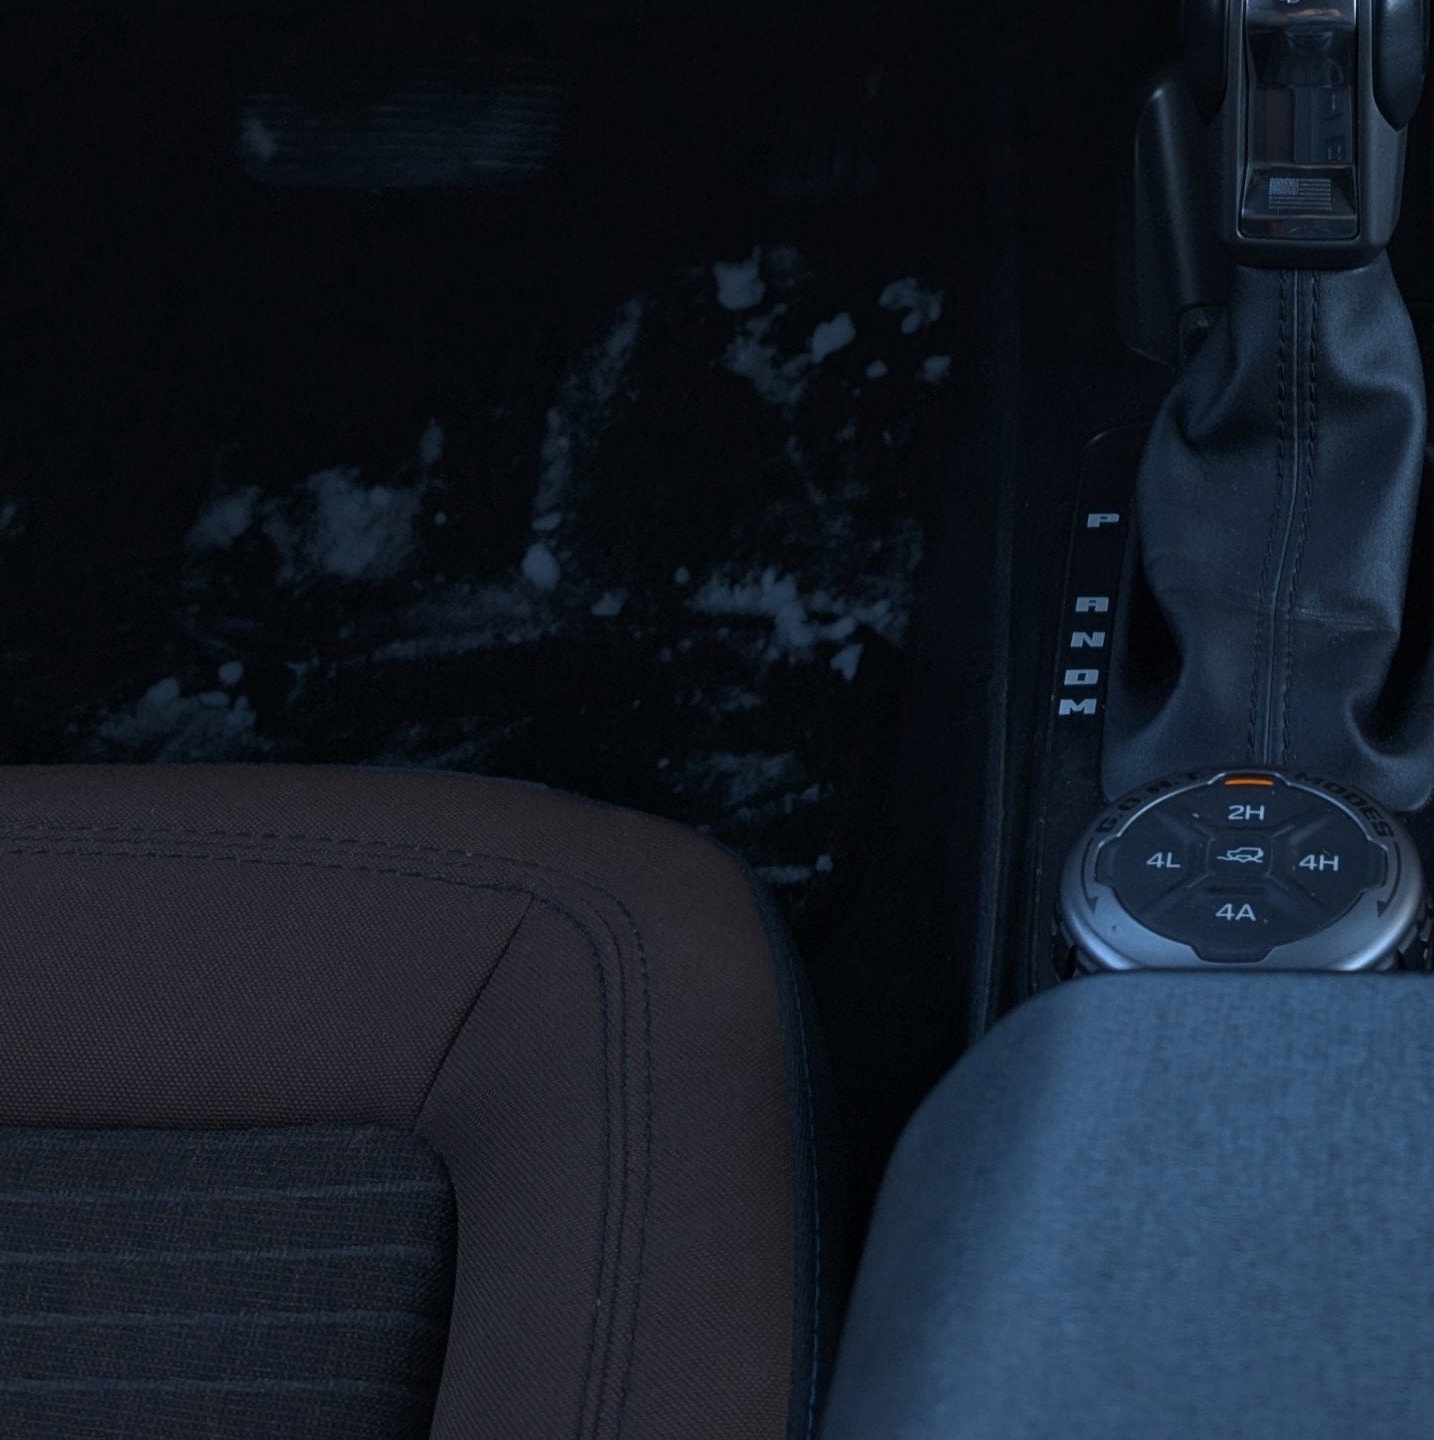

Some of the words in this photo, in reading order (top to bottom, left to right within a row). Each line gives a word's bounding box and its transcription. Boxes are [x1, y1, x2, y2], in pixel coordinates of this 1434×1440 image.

[1087, 513, 1119, 528] P
[1070, 631, 1106, 648] N
[1063, 668, 1100, 685] D
[1058, 698, 1098, 715] M
[1227, 804, 1265, 821] 2H
[1295, 772, 1395, 837] MODES
[1146, 852, 1181, 869] 4L
[1298, 855, 1340, 872] 4H
[1215, 903, 1256, 921] 4A
